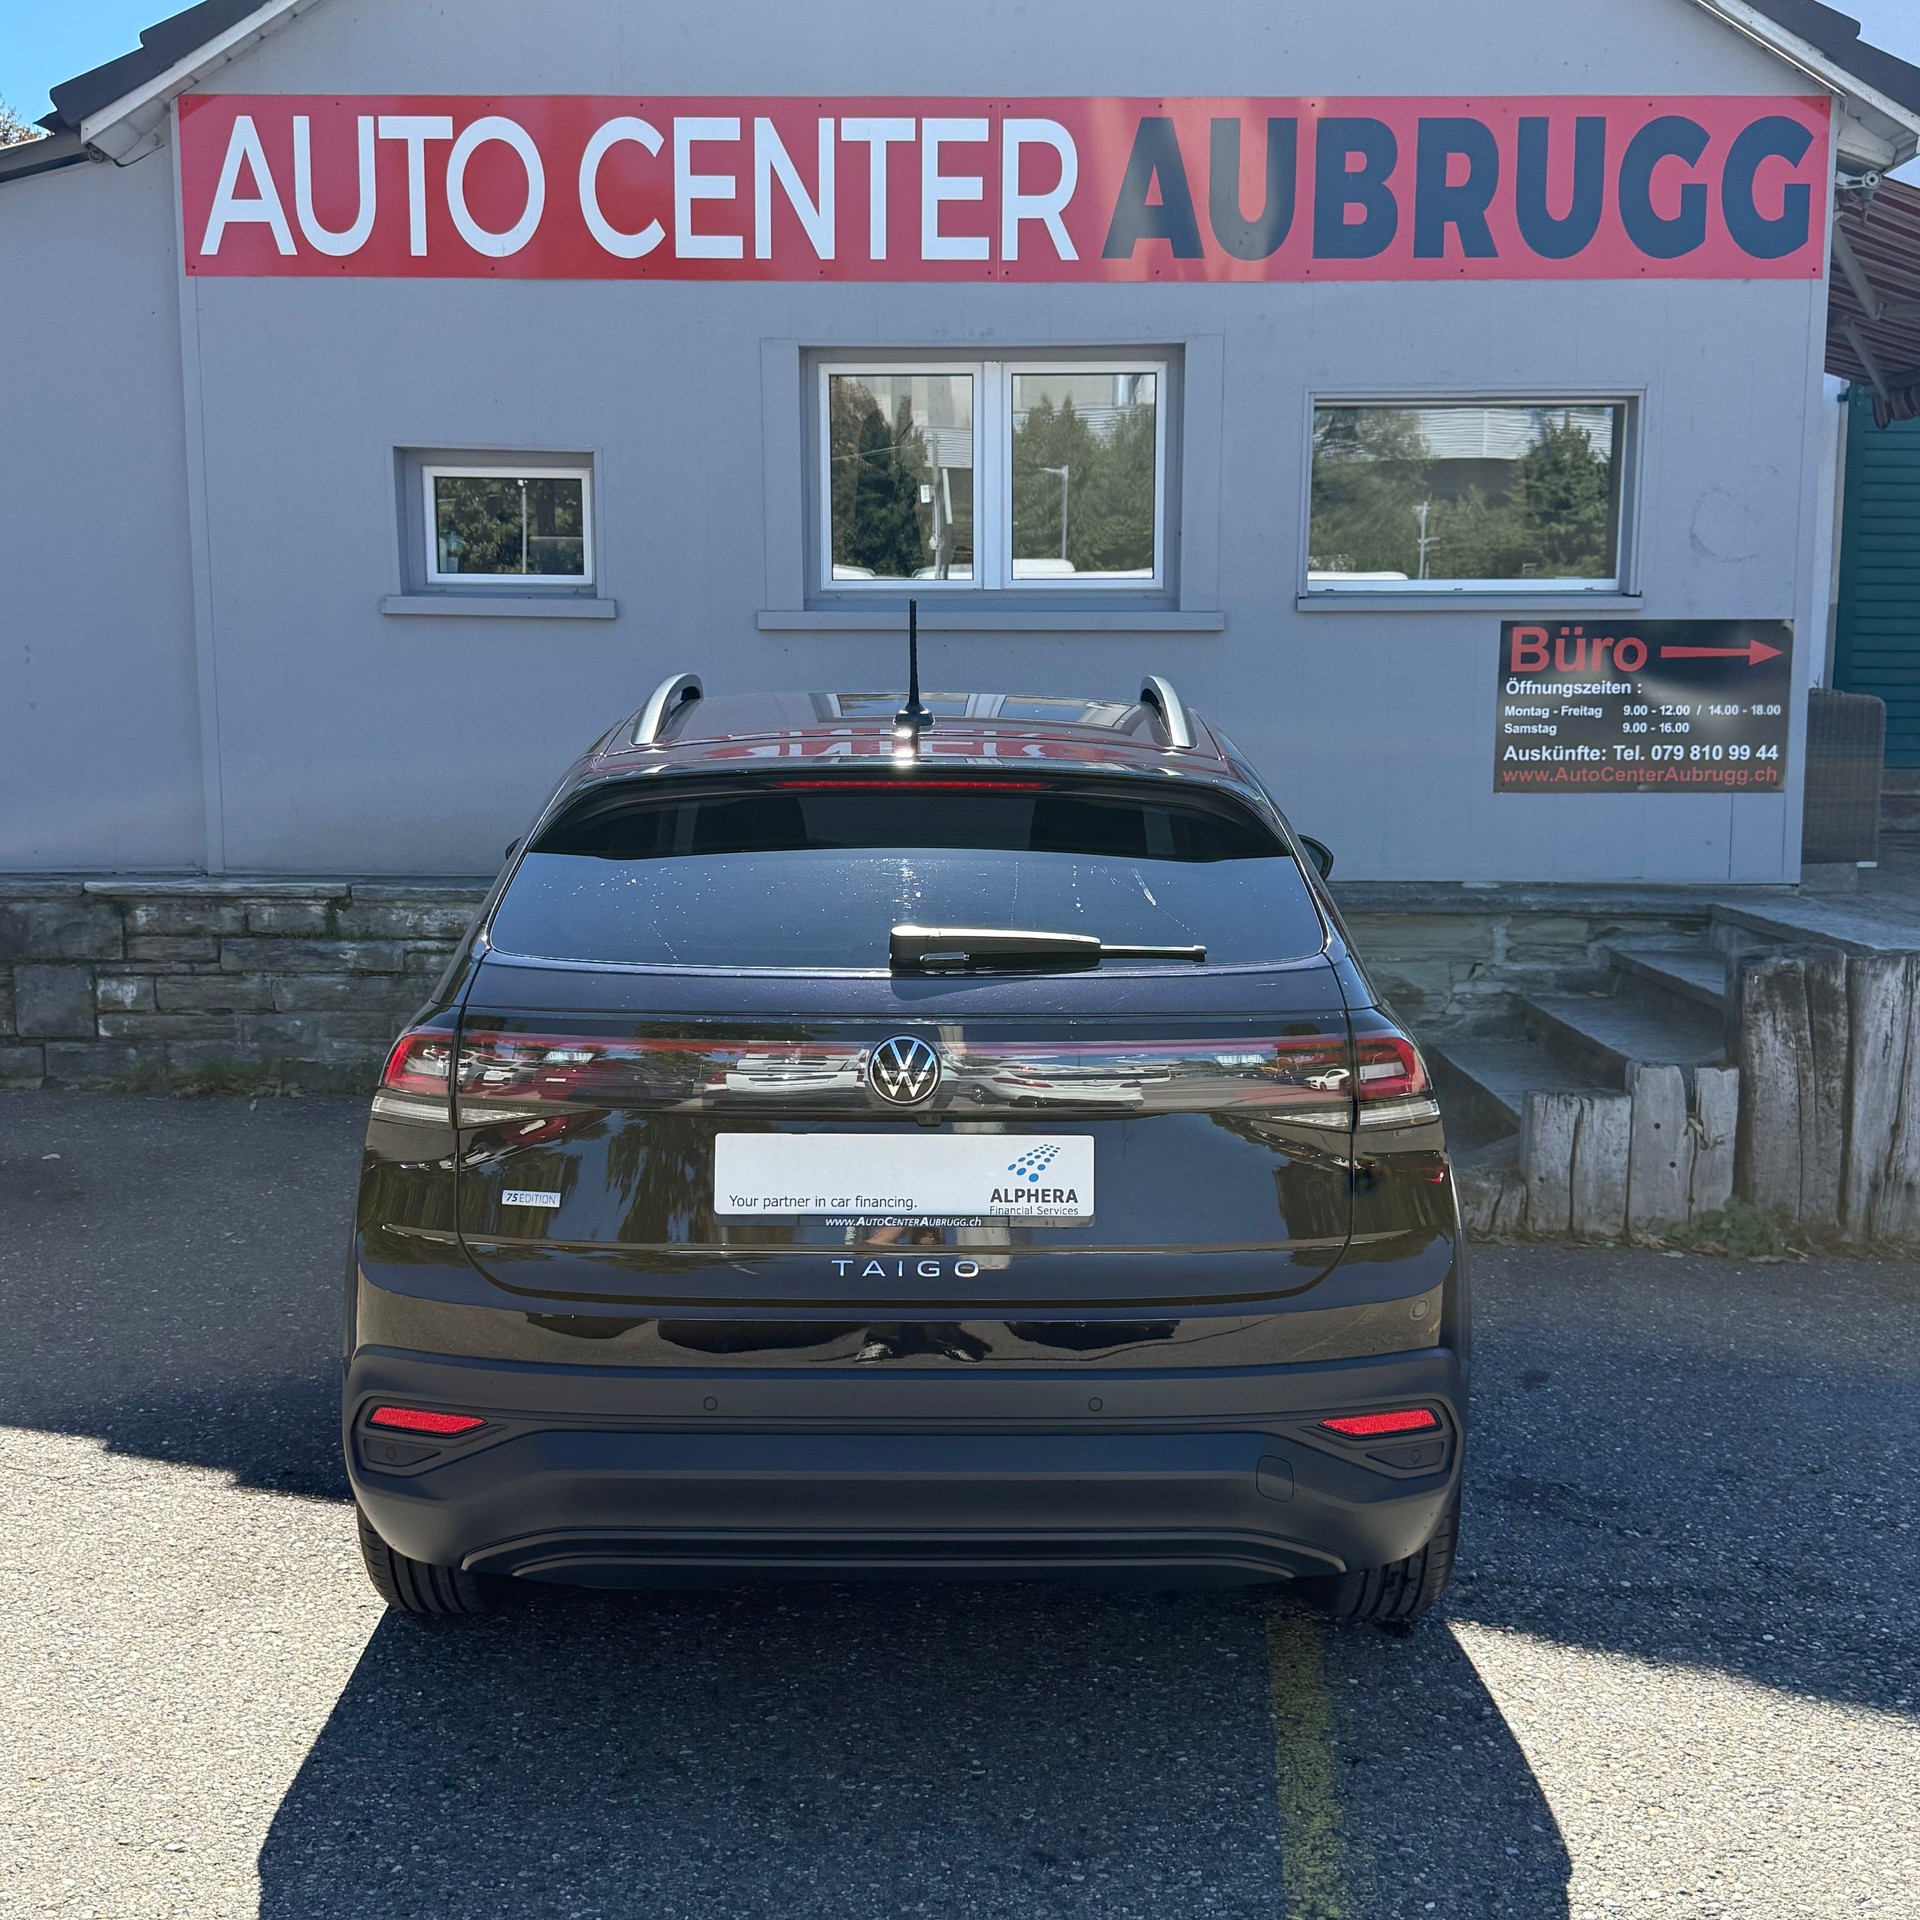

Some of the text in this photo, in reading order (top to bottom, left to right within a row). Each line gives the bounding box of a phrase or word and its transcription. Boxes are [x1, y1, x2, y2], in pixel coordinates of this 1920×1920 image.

[200, 115, 1815, 261] AUTO CENTER AUBRUGG
[1510, 626, 1648, 672] Büro
[1505, 677, 1632, 698] Öffnungszeiten
[1504, 705, 1550, 719] Montag
[1560, 705, 1603, 718] Freitag
[1622, 704, 1648, 716] 9.00
[1659, 704, 1690, 716] 12.00
[1708, 704, 1739, 716] 14.00
[1750, 704, 1781, 716] 18.00
[1504, 723, 1558, 736] Samstag
[1622, 722, 1648, 733] 9.00
[1658, 722, 1690, 733] 16.00
[1503, 744, 1779, 761] Auskünfte: Tel. 079 810 99 44
[1502, 766, 1778, 786] www.AutoCenterAubrugg.ch
[729, 1195, 918, 1211] Your partner in car financing.
[989, 1188, 1079, 1204] ALPHERA
[989, 1205, 1079, 1216] Financial Services
[831, 1259, 980, 1279] TAIGO
